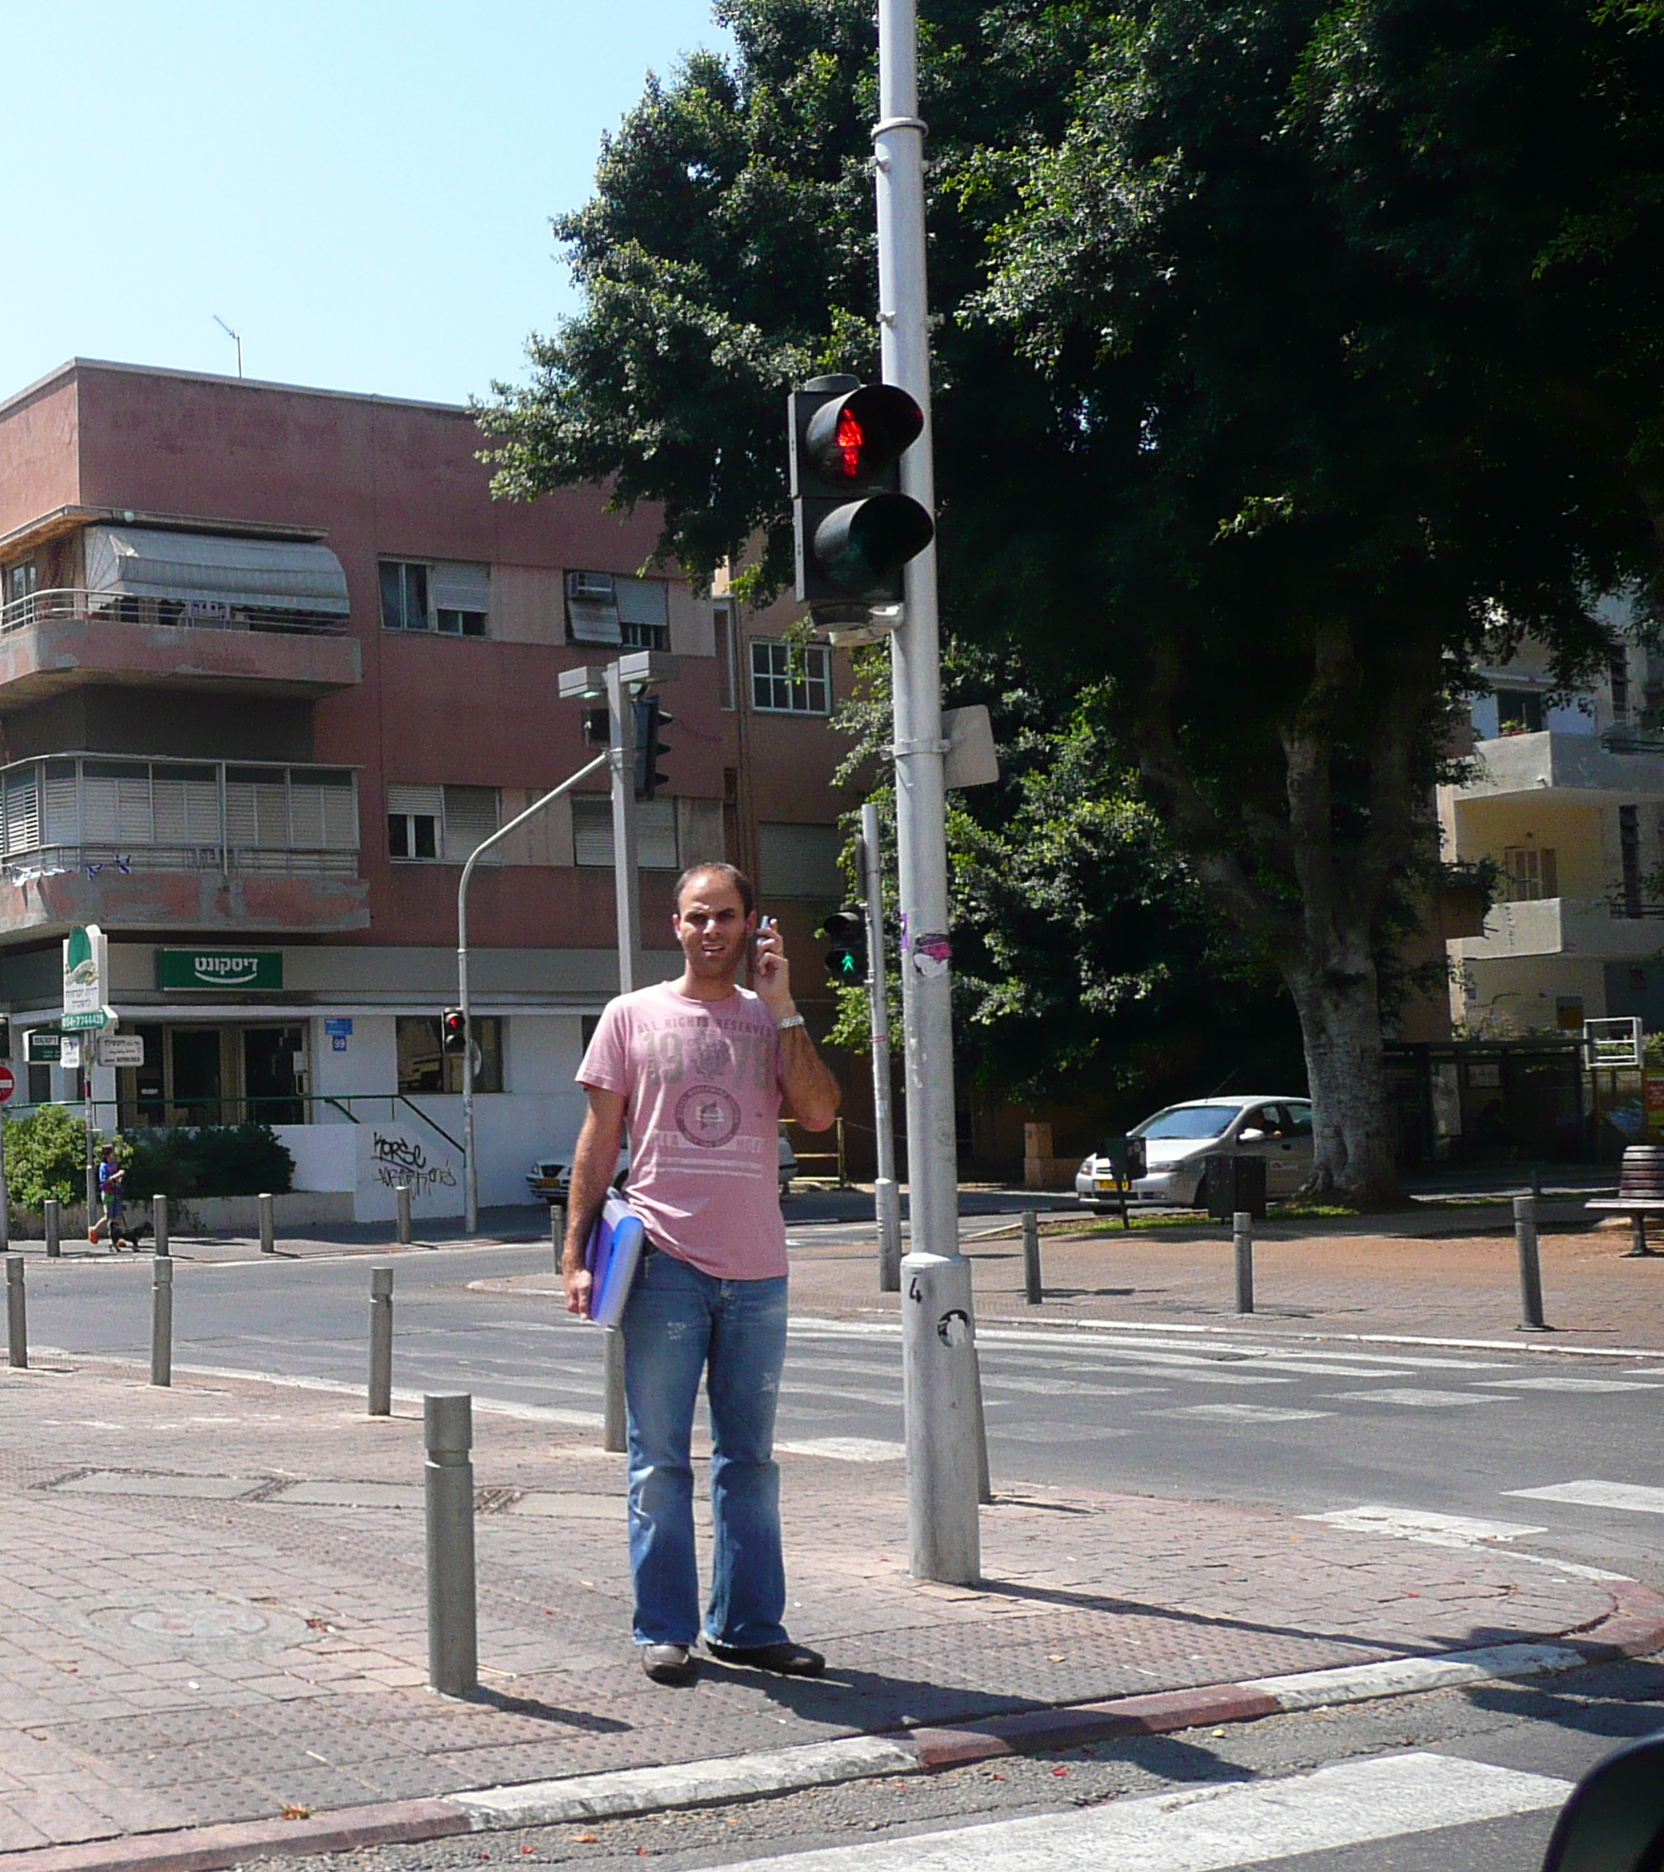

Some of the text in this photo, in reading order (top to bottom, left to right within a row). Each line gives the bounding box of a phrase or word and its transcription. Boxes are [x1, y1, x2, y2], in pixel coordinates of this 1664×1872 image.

[194, 957, 259, 975] דיסקונט
[637, 1021, 657, 1034] ALL
[666, 1016, 709, 1029] RIGHTS
[909, 1277, 923, 1304] 4
